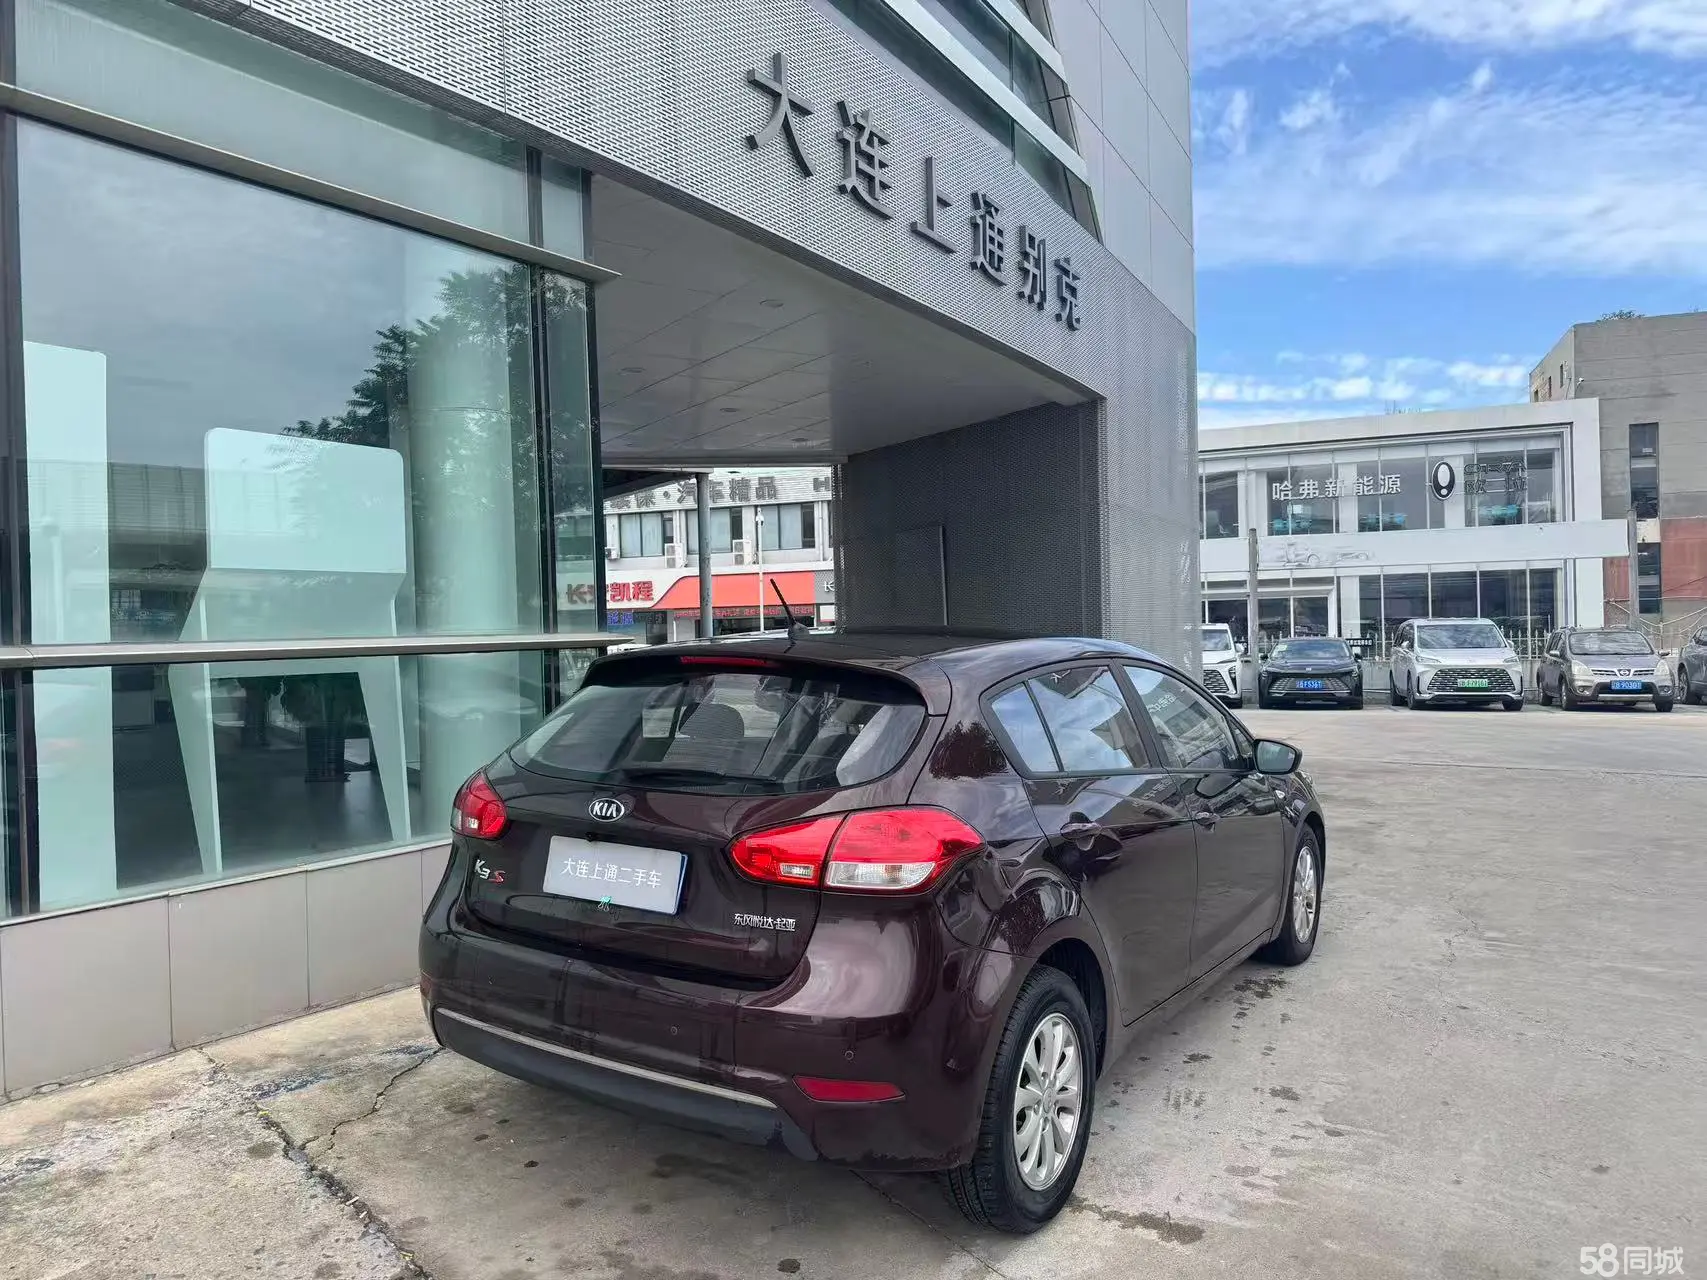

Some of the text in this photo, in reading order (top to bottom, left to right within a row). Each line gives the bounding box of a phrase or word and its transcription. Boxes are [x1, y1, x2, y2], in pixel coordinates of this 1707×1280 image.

[745, 52, 1081, 331] 大连上通别克
[1272, 474, 1401, 501] 哈弗新能源
[592, 801, 618, 818] KIA
[562, 857, 662, 889] 大连上通二手车
